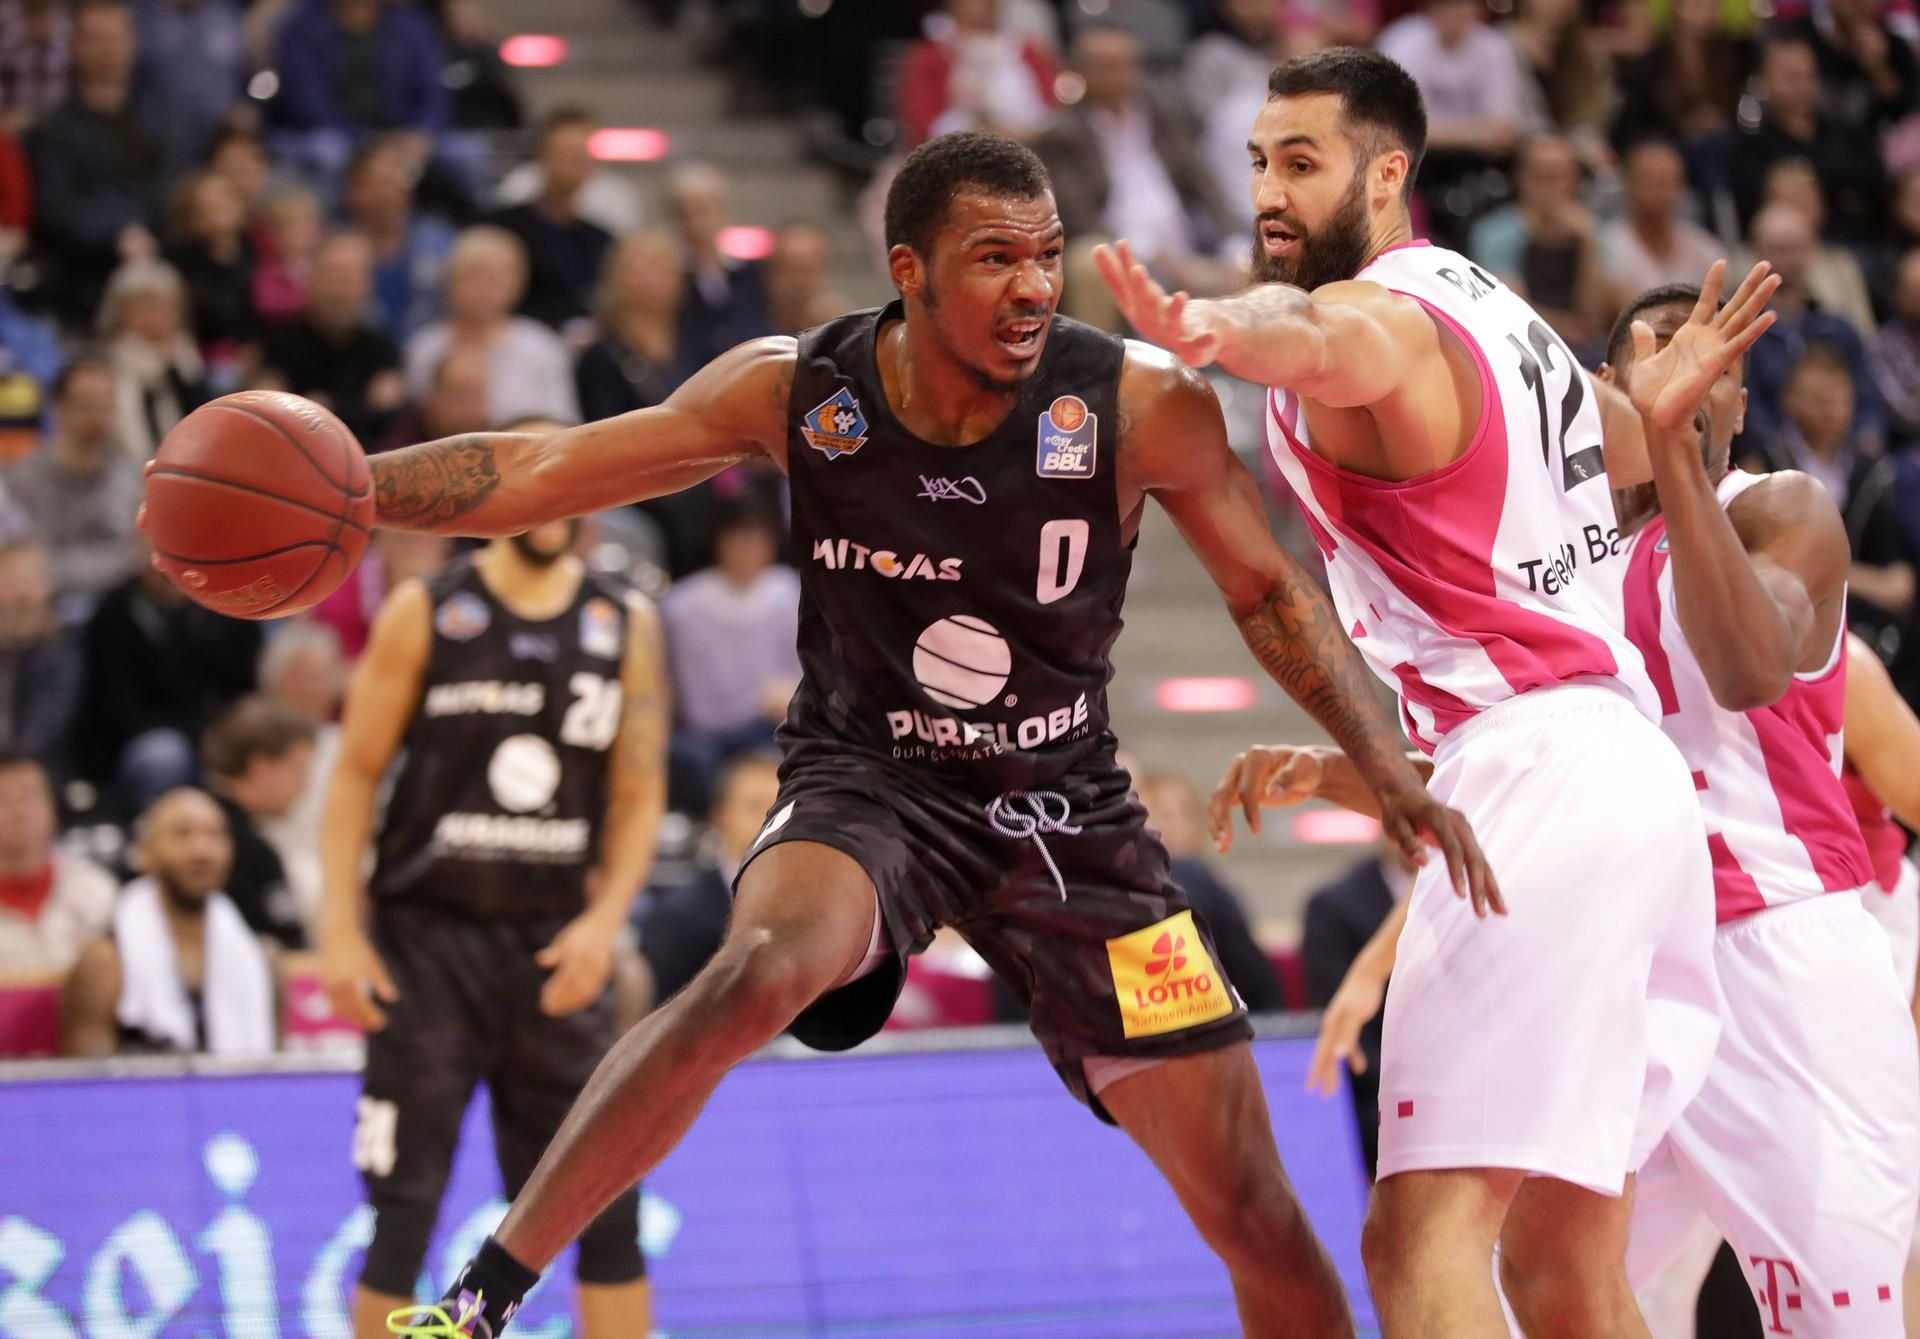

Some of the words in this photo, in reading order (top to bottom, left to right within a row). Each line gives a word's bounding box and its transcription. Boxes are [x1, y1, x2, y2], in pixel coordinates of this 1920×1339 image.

[1506, 320, 1606, 493] 12
[1043, 452, 1088, 471] BBL
[813, 538, 963, 581] MITGAS
[1037, 519, 1089, 605] 0
[1135, 975, 1211, 1008] LOTTO
